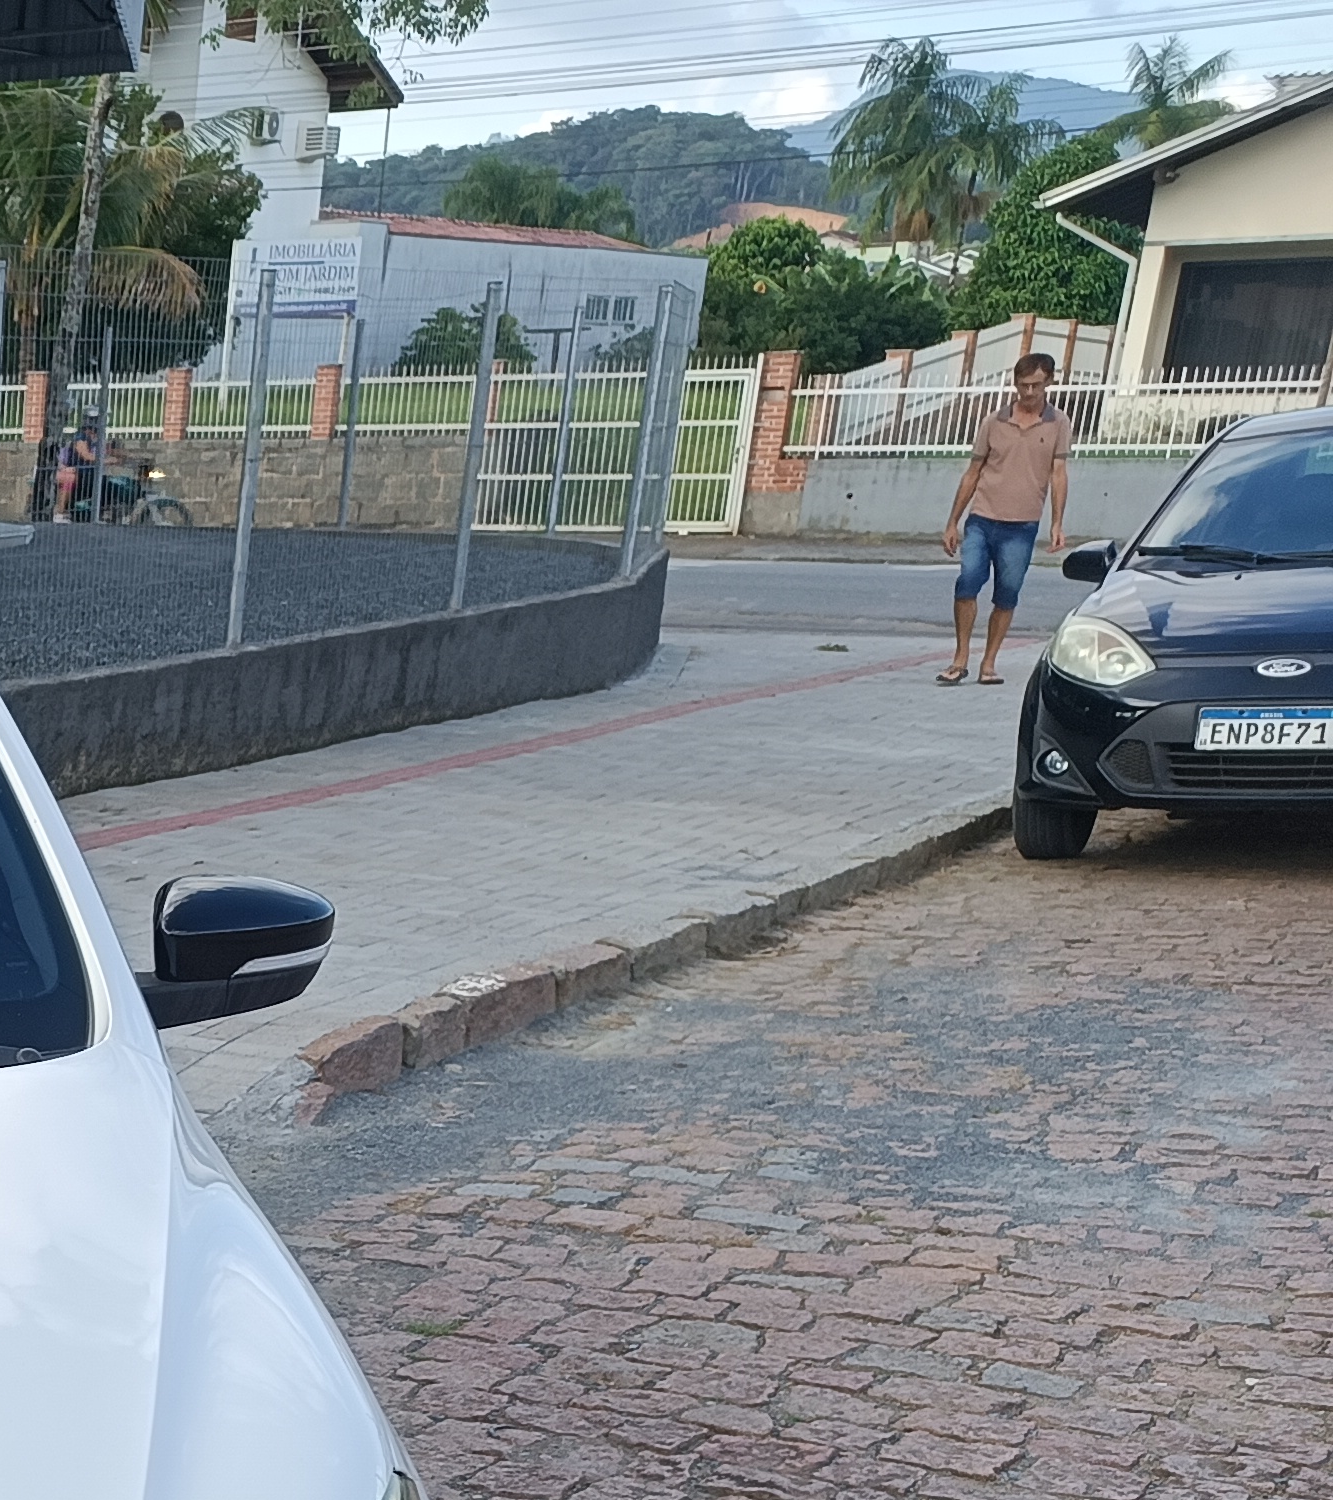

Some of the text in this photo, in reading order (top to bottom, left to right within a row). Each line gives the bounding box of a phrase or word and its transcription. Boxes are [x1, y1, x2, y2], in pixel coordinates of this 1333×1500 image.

[269, 240, 356, 259] IMOBILIÁRIA
[276, 265, 355, 285] OM JARDIM
[1209, 722, 1327, 744] ENP8F71
